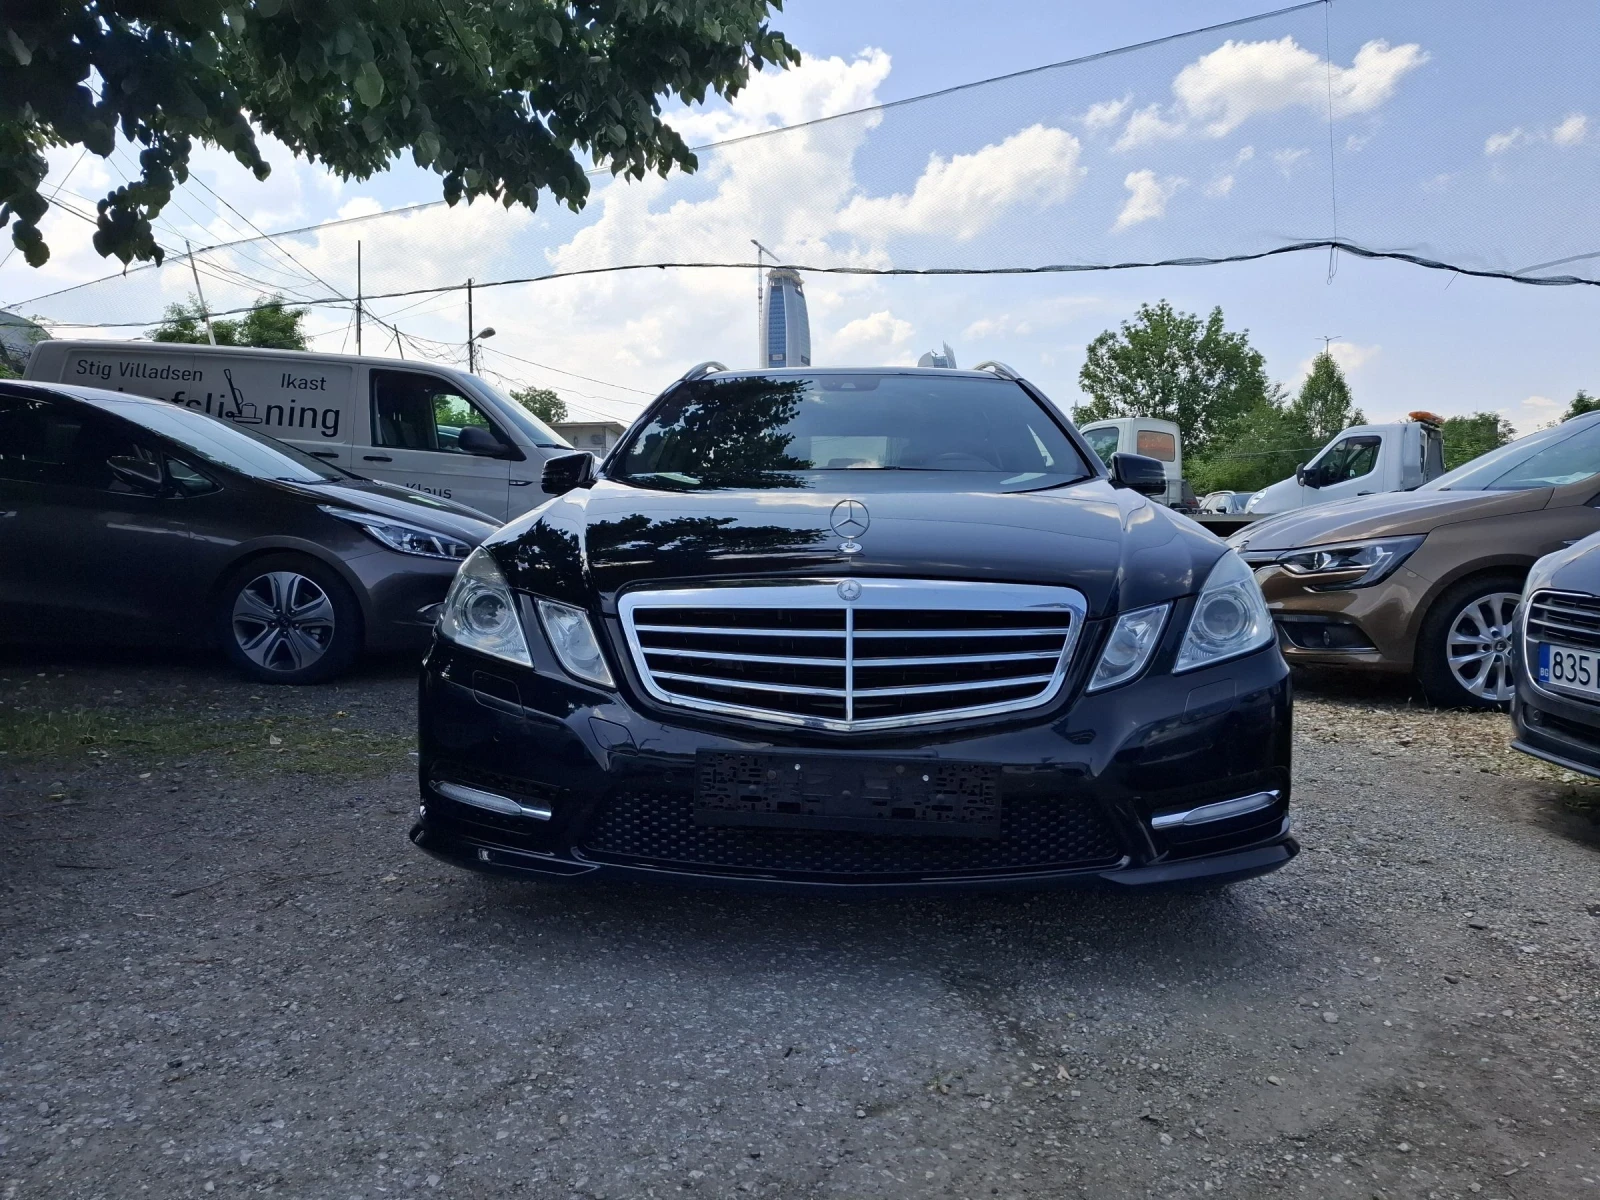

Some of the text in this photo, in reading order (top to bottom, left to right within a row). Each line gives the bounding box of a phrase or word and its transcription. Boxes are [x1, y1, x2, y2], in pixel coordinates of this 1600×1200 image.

[76, 359, 203, 381] Stig Villadsen
[281, 373, 326, 391] Ikast
[1540, 667, 1549, 677] BG
